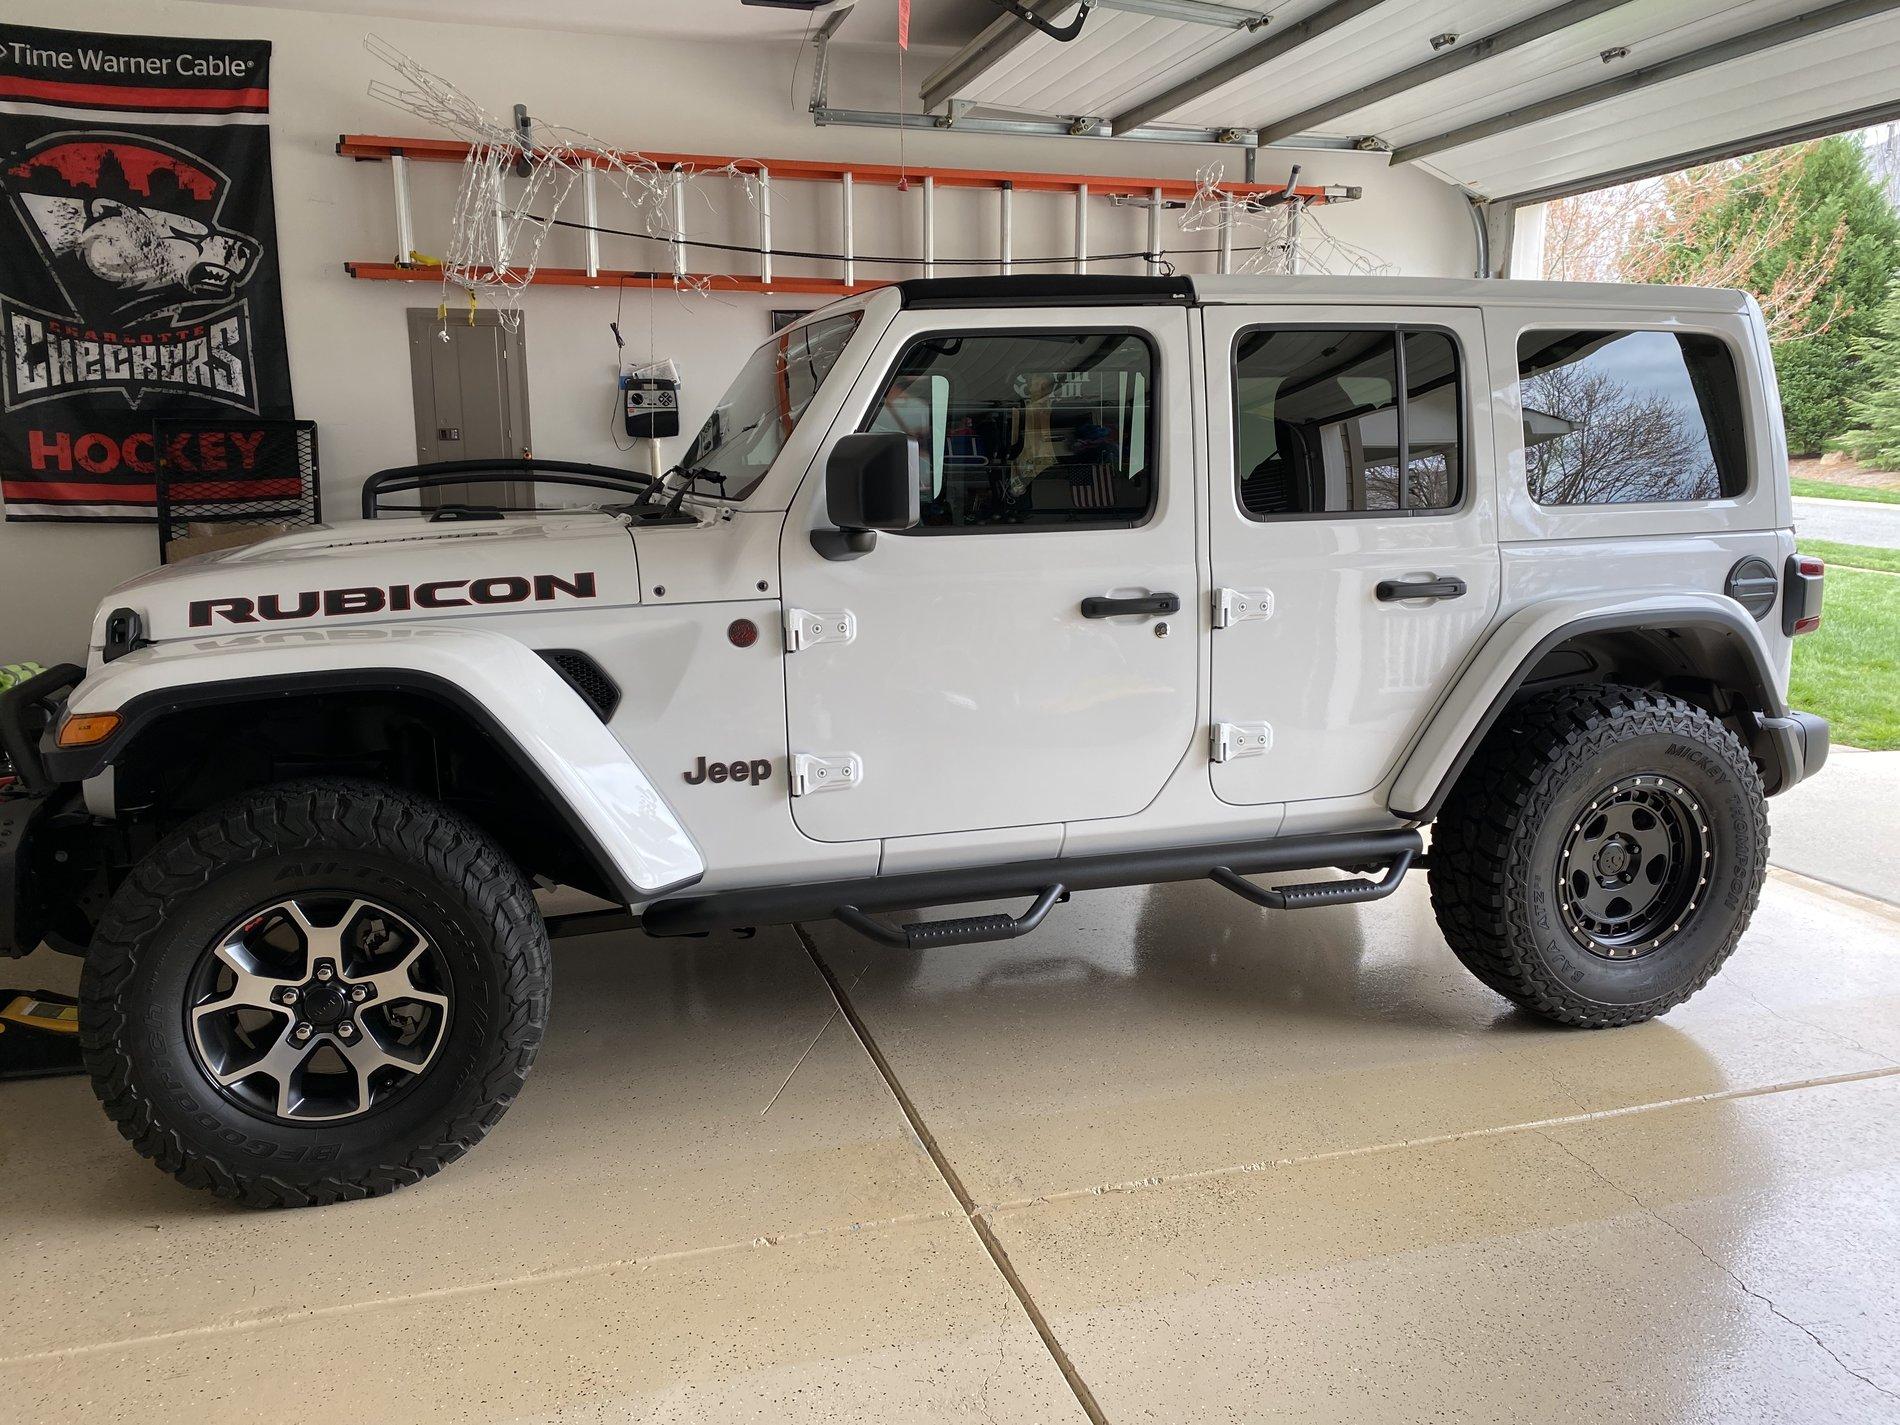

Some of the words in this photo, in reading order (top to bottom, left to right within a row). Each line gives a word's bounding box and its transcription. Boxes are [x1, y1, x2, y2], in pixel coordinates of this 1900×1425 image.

[8, 42, 73, 68] Time
[77, 48, 171, 75] Warner
[10, 311, 246, 394] CHECKERS
[49, 319, 205, 344] CHARLOTTE
[28, 430, 265, 474] HOCKEY
[188, 572, 597, 628] RUBICON
[682, 756, 772, 786] Jeep
[1664, 742, 1732, 786] MICKEY
[1723, 793, 1750, 912] THOMPSON
[1546, 938, 1585, 984] BAJA
